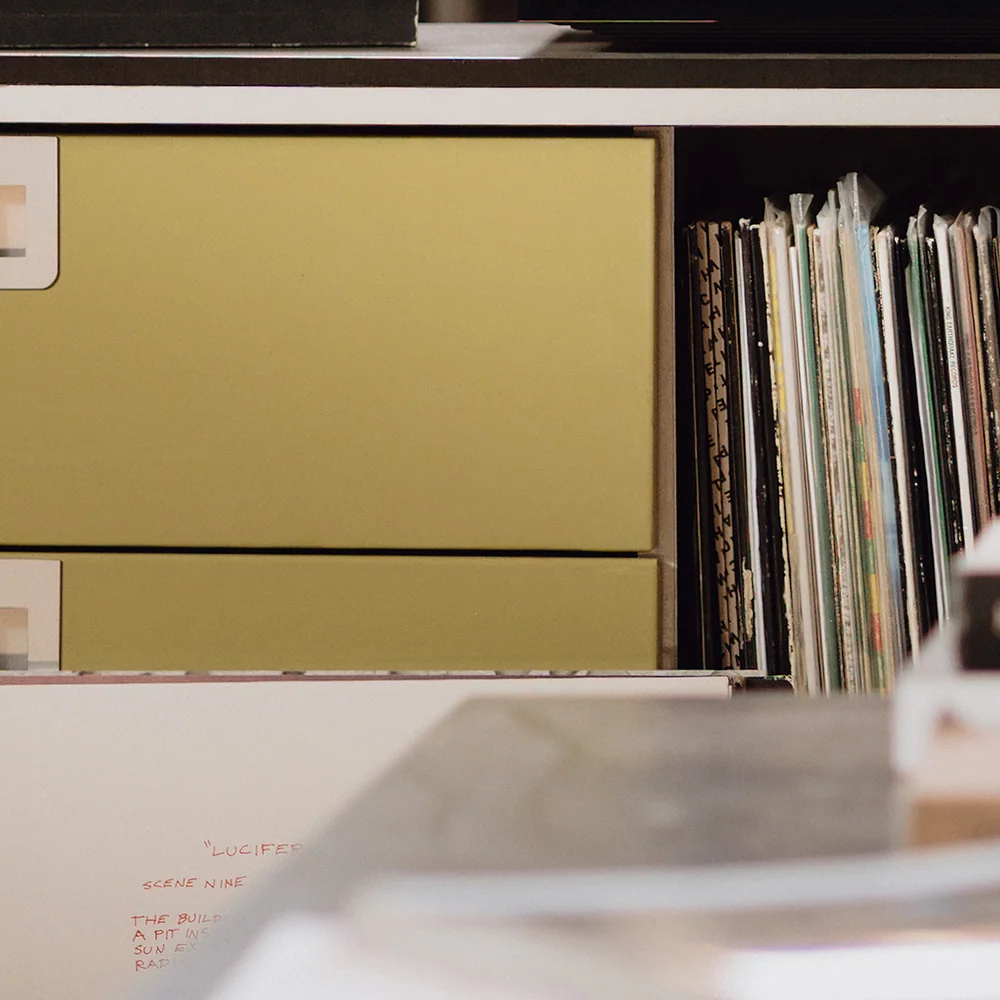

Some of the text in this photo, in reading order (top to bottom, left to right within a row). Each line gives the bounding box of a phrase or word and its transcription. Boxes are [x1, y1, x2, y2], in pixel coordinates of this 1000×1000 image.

[142, 875, 247, 891] SCENE NINE
[131, 914, 170, 927] THE
[132, 929, 146, 942] A
[153, 928, 181, 941] PIT
[133, 943, 166, 956] SUN
